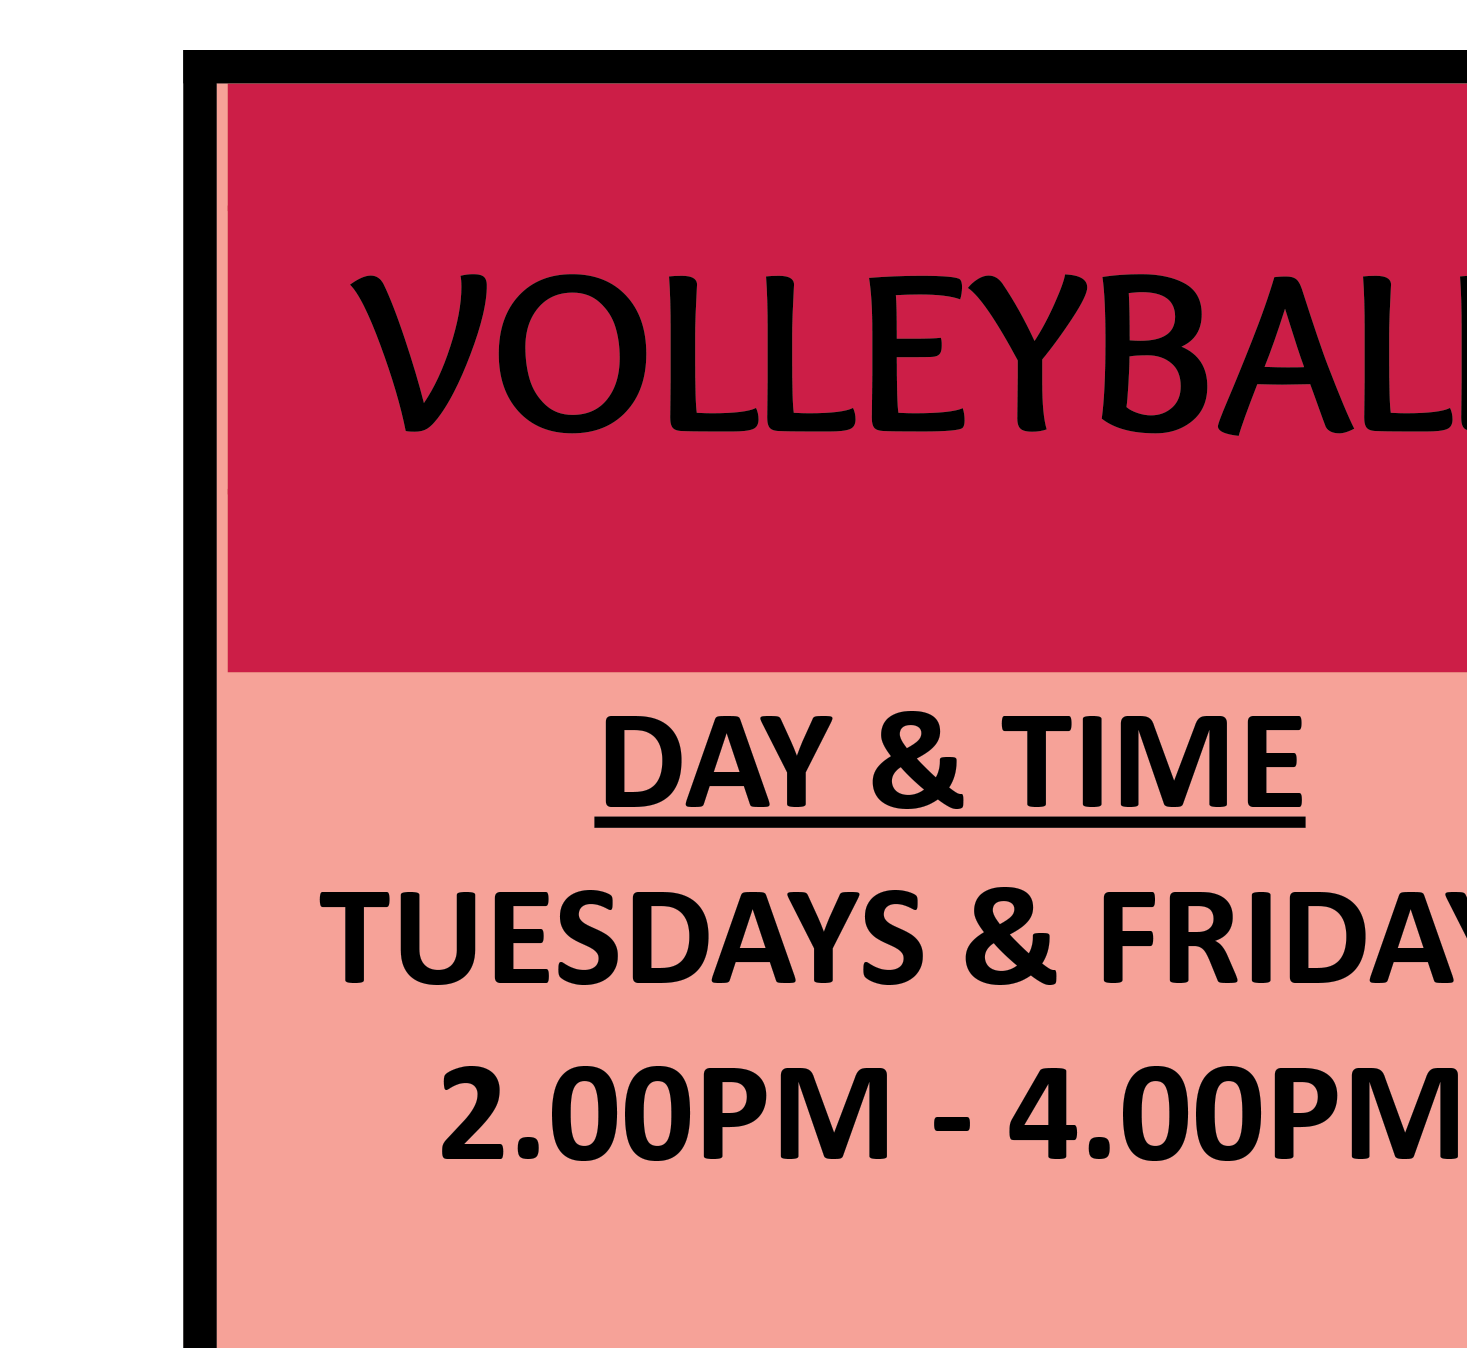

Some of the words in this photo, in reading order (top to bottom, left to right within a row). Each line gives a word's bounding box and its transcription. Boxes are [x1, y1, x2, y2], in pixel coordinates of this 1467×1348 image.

[602, 716, 832, 807] DAY
[873, 711, 963, 809] &
[1002, 716, 1302, 807] TIME
[320, 890, 923, 985] TUESDAYS
[966, 887, 1056, 985] &
[442, 1066, 887, 1161] 2.00PM
[1010, 1066, 1458, 1161] 4.00PM
